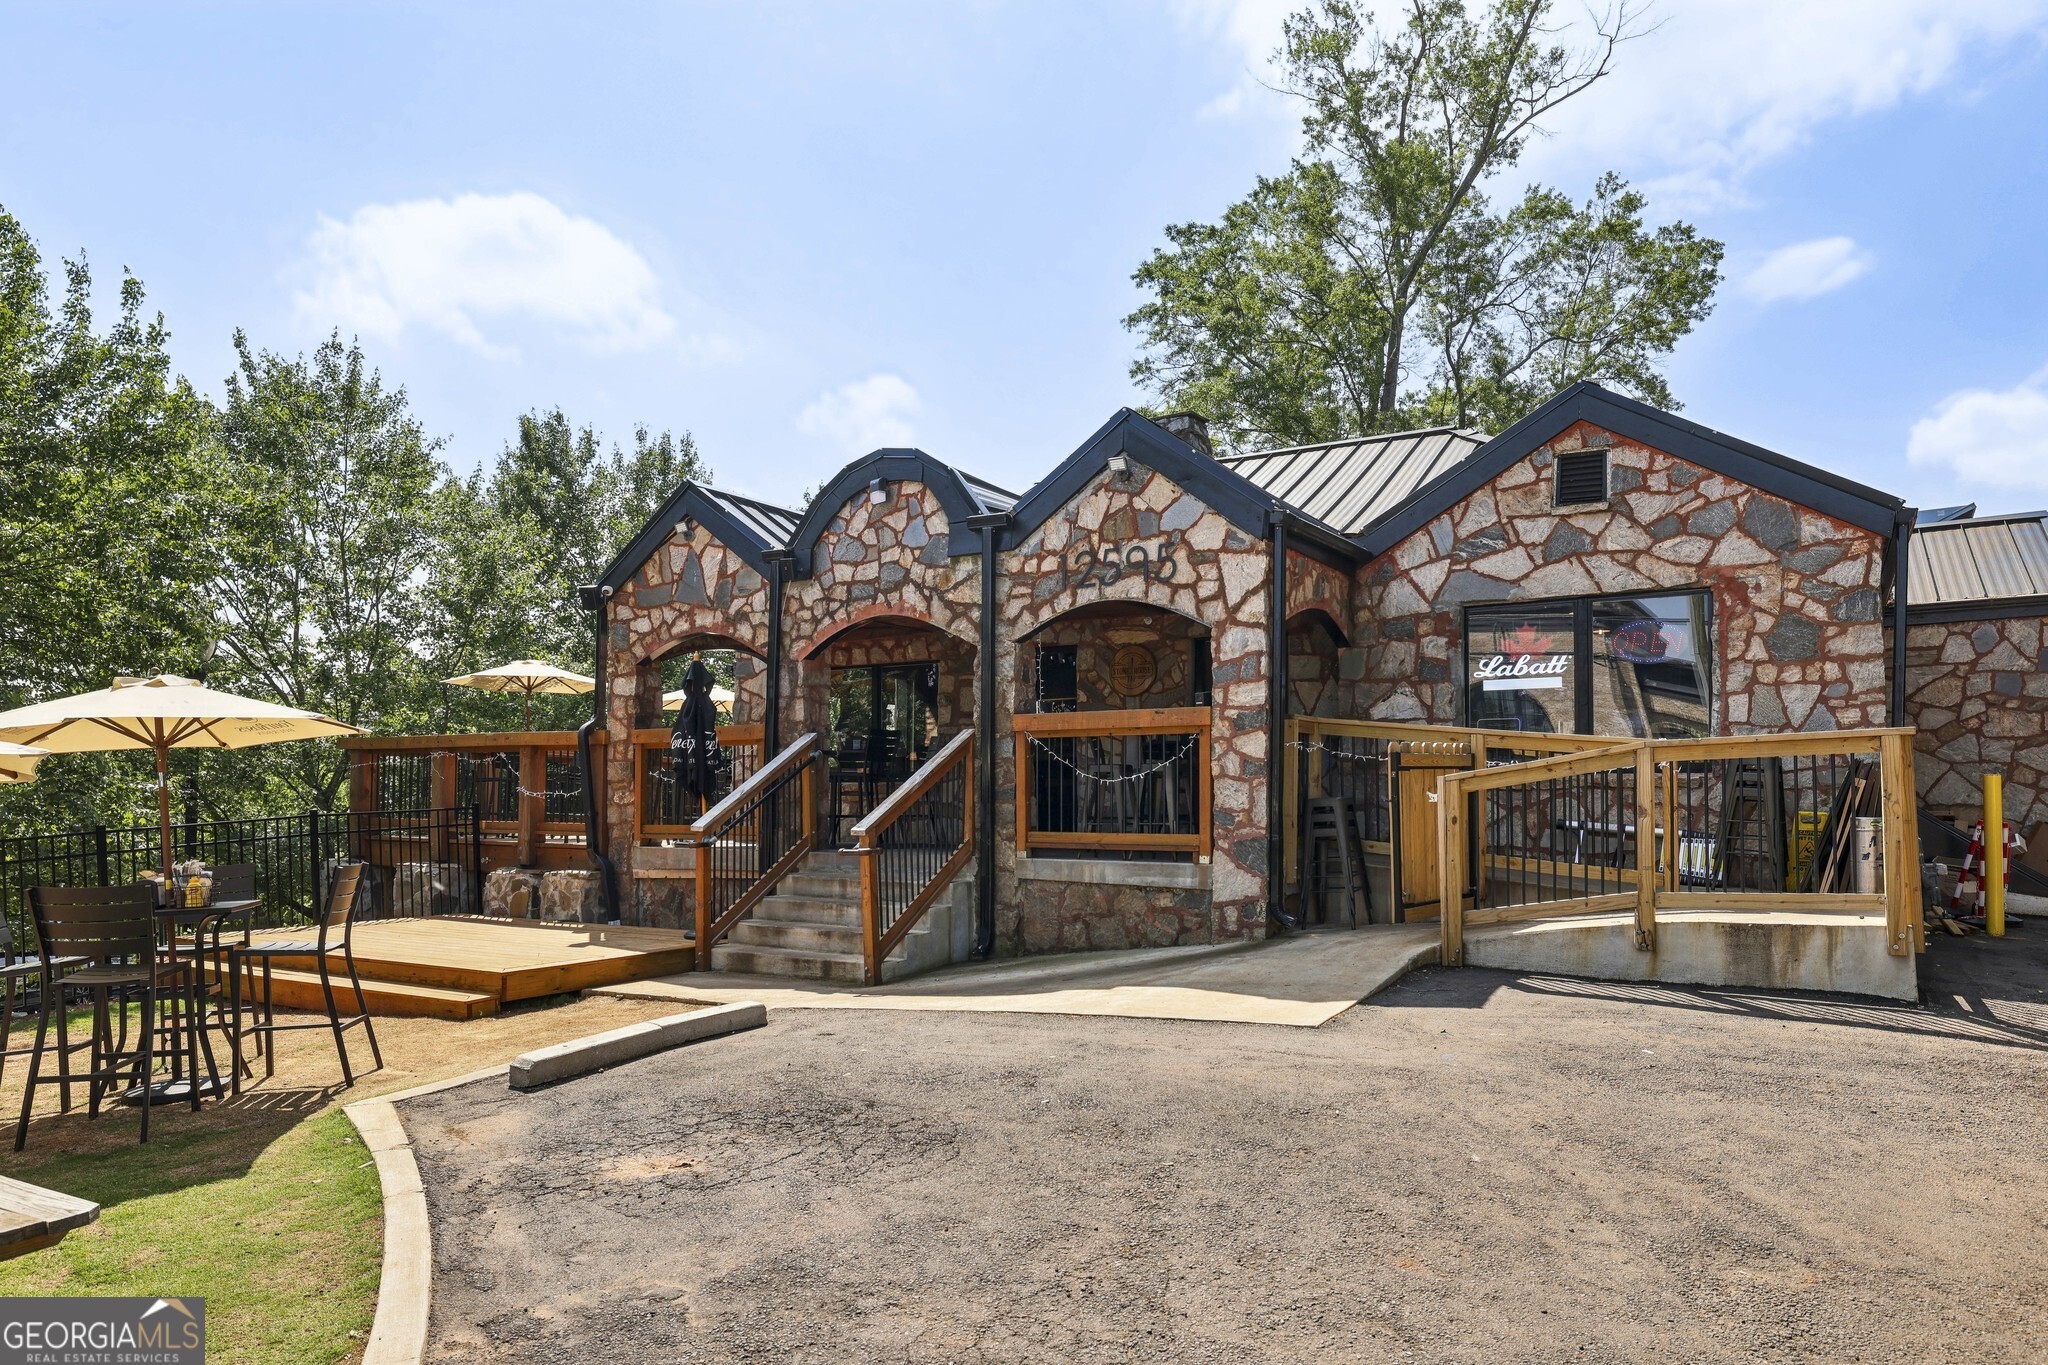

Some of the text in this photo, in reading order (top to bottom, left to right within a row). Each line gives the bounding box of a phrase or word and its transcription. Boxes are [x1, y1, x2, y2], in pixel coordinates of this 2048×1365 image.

[1059, 541, 1177, 591] 12595
[1612, 631, 1684, 653] OPEN
[1473, 654, 1569, 678] Labatt
